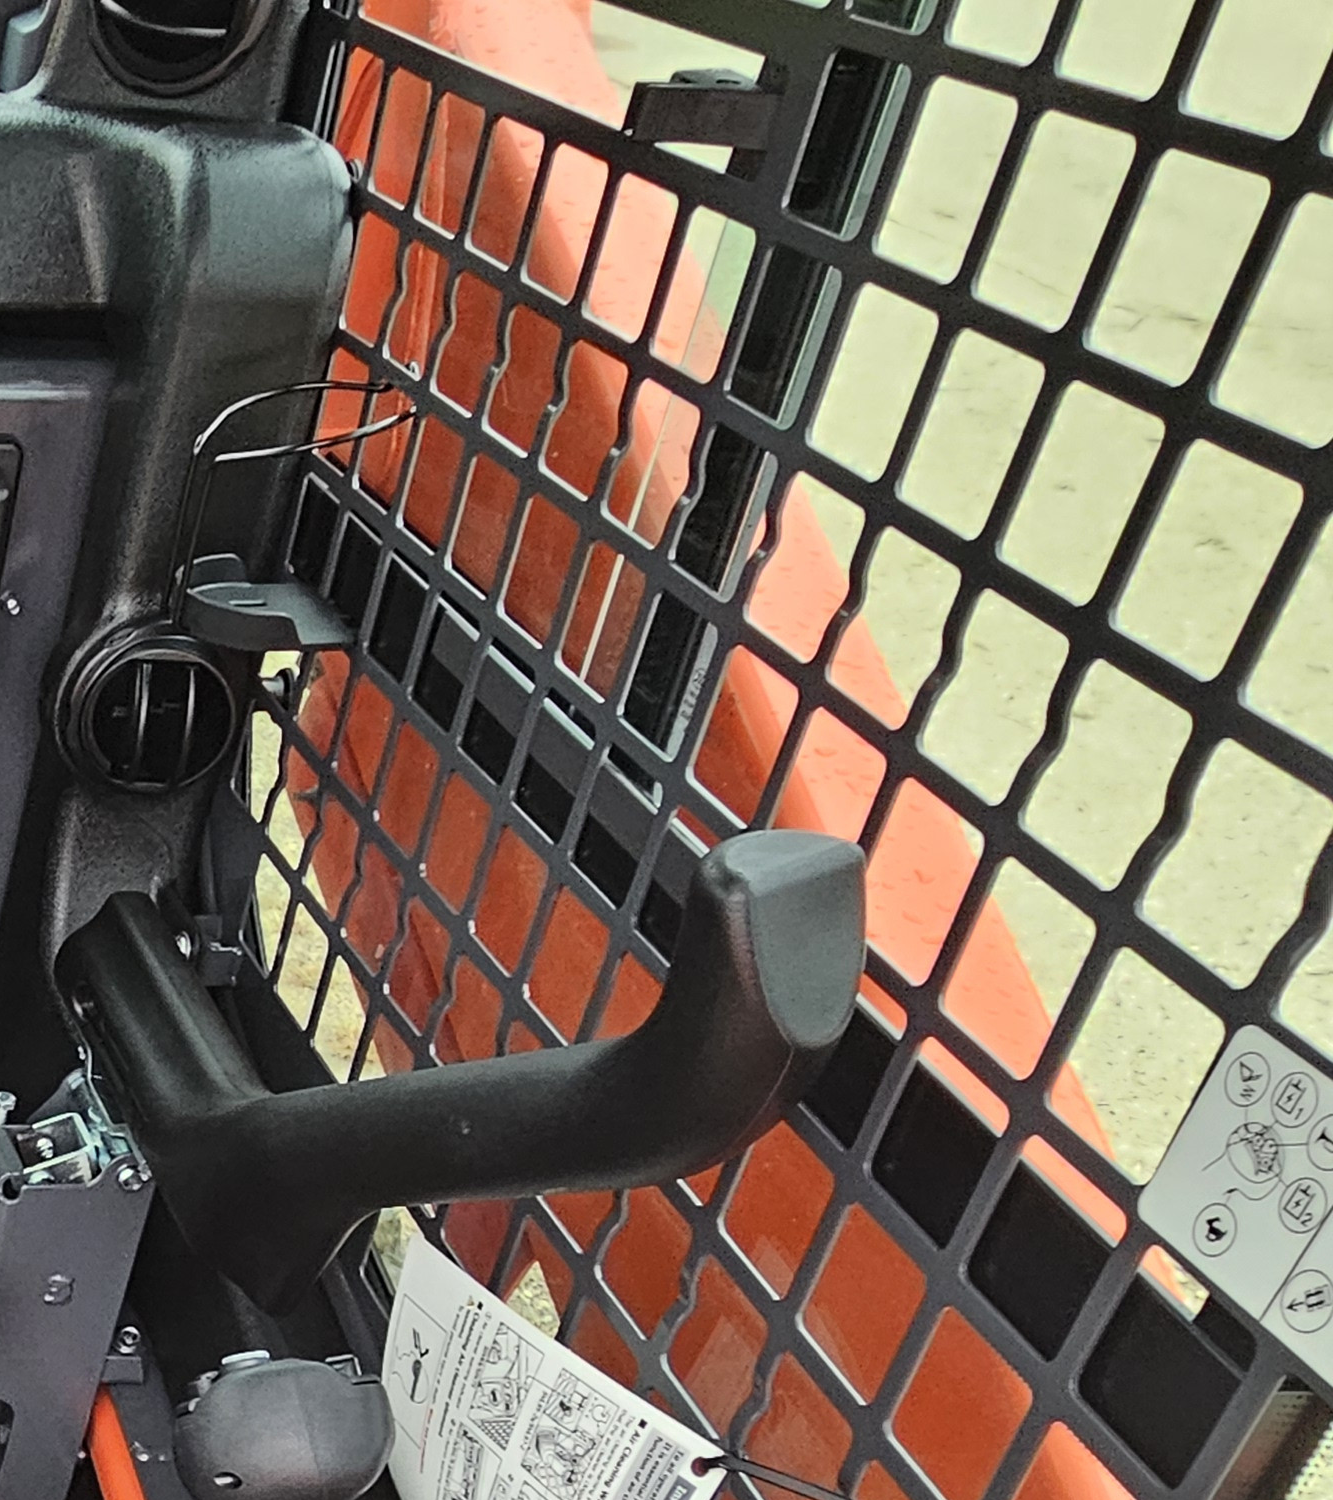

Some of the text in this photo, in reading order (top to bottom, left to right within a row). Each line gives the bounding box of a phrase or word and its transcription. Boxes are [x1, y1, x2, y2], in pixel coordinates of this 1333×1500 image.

[1300, 1212, 1314, 1227] 2
[460, 1311, 481, 1351] Cleaning
[628, 1429, 642, 1446] Air
[639, 1435, 664, 1471] function
[662, 1441, 672, 1452] It
[657, 1450, 667, 1460] is
[672, 1449, 684, 1462] To
[603, 1445, 633, 1489] Cleaning
[665, 1461, 676, 1474] all
[635, 1459, 661, 1499] essential
